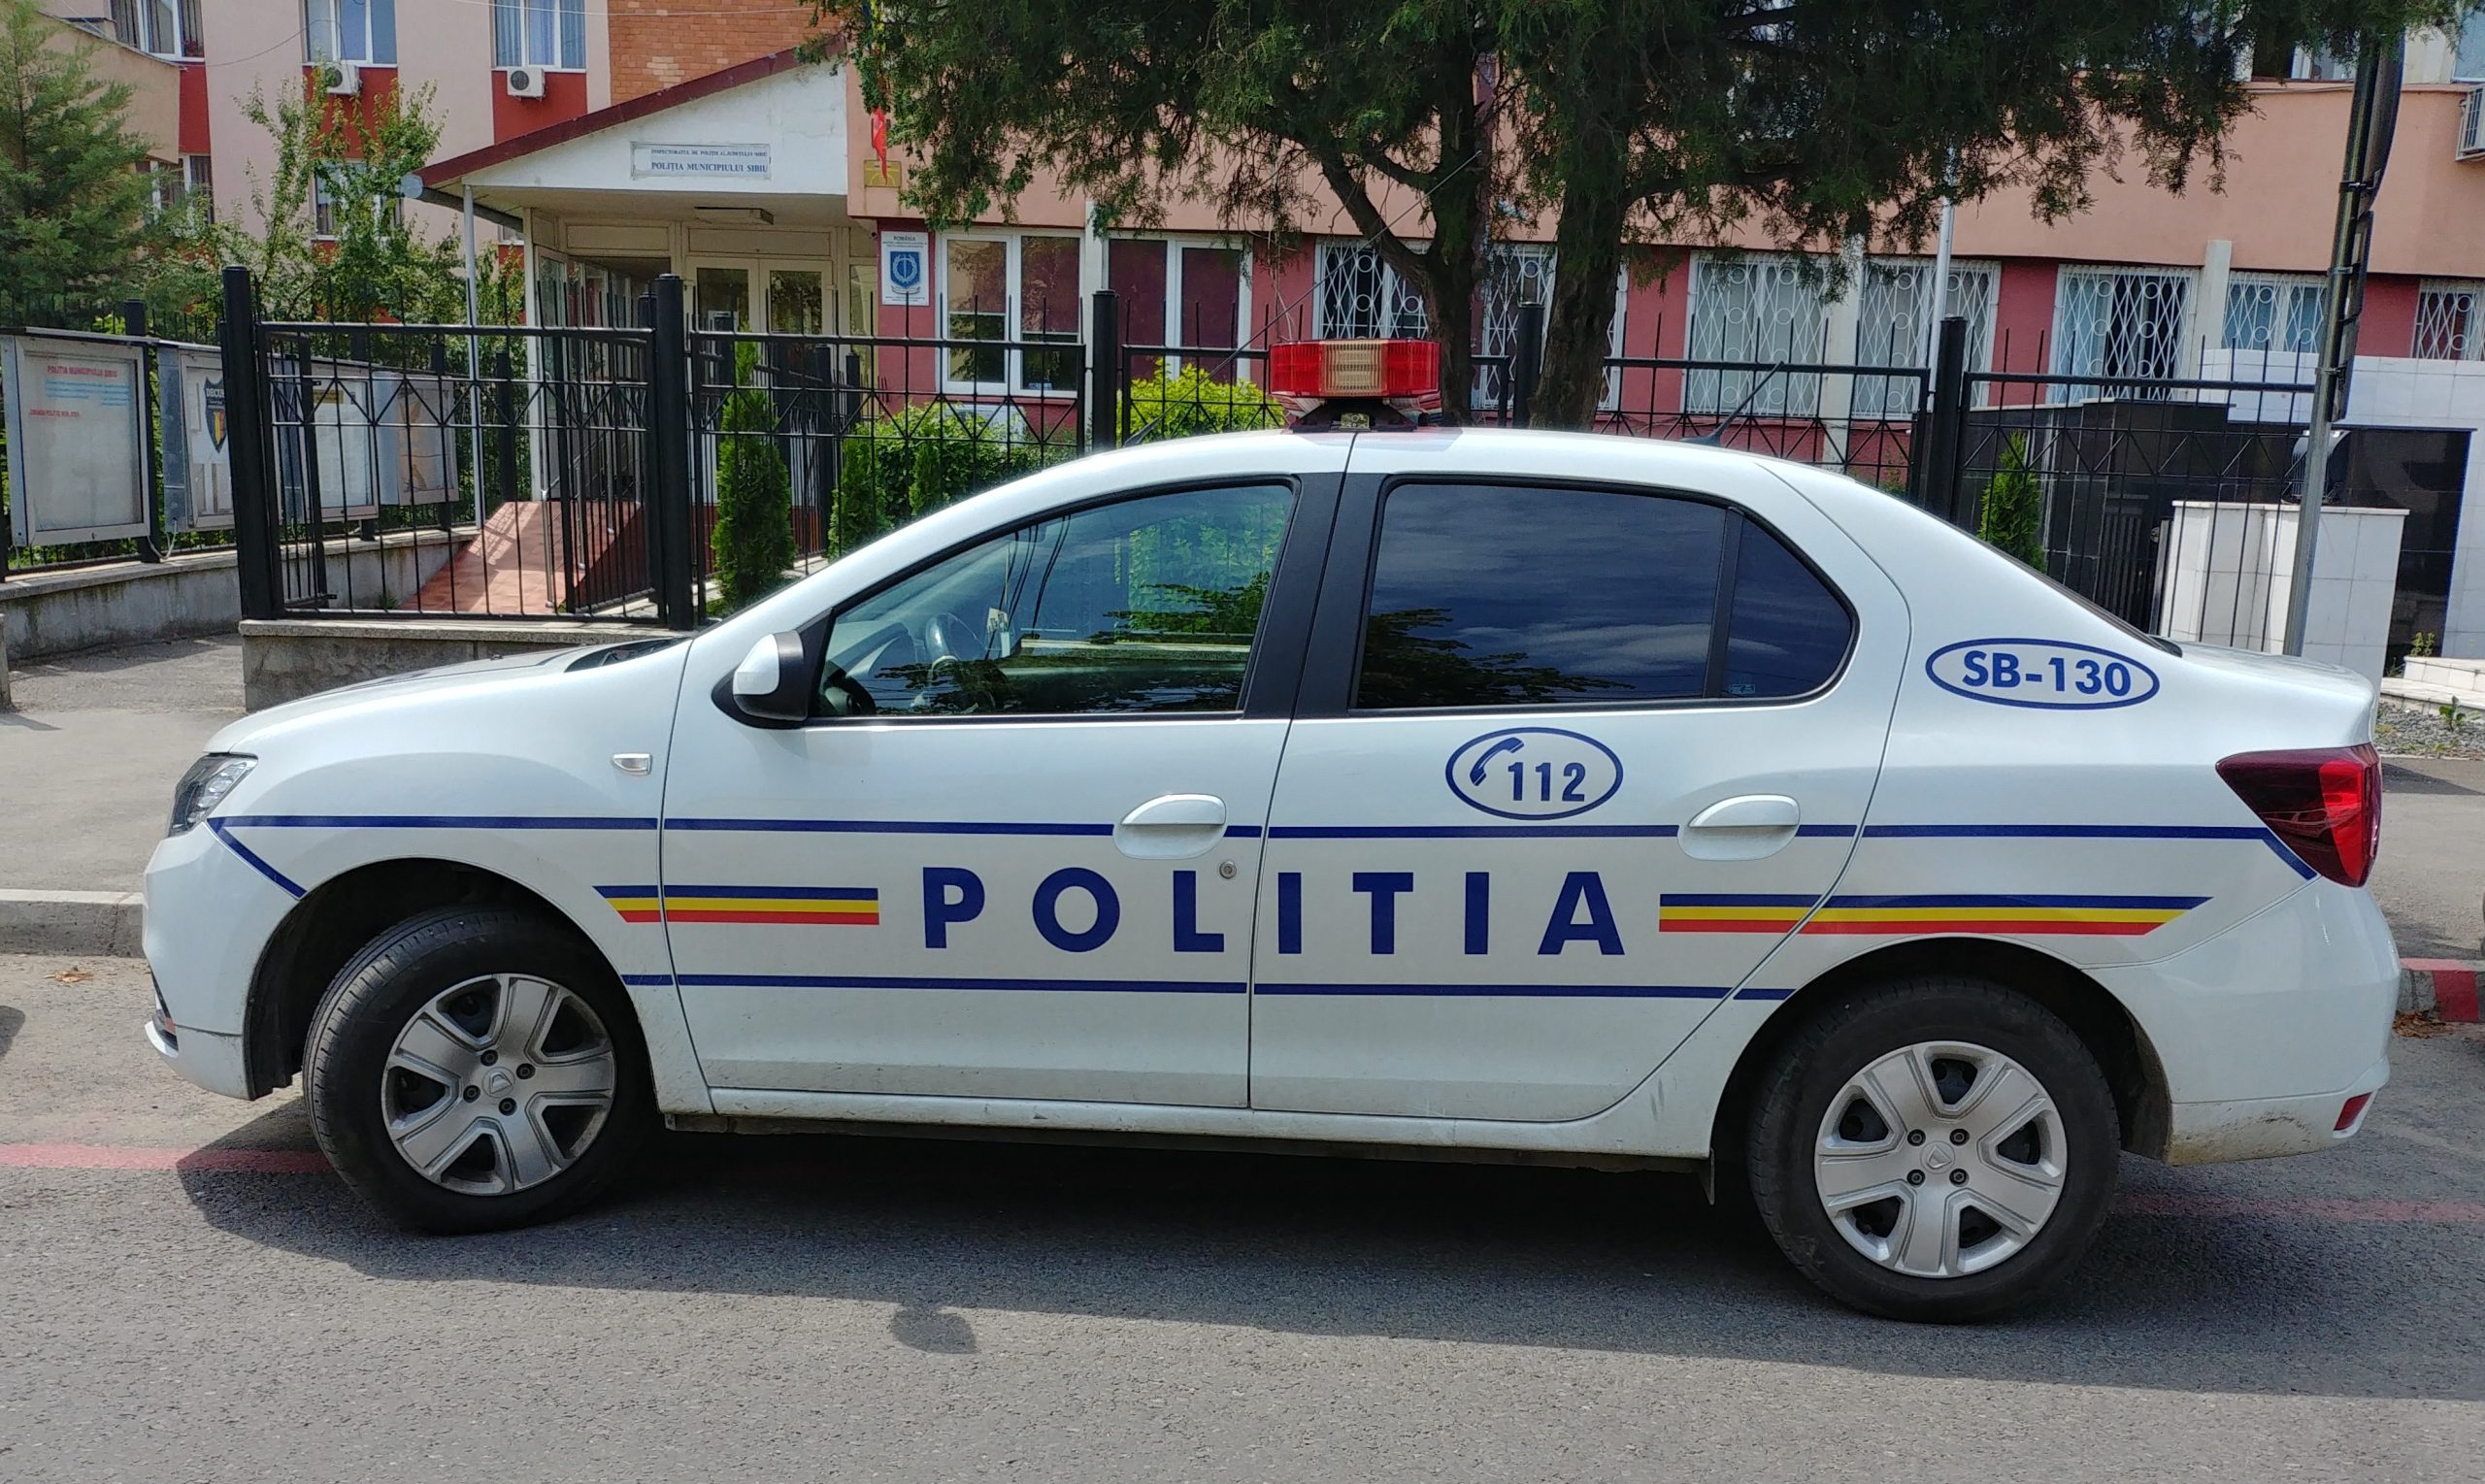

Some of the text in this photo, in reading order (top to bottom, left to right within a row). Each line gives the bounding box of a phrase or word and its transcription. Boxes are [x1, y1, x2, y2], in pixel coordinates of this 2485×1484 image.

[686, 163, 744, 172] MUNICIPIULUI
[746, 164, 768, 173] SIBIU
[1962, 649, 2132, 697] SB-130
[1508, 761, 1586, 802] 112
[922, 866, 1625, 956] POLITIA
